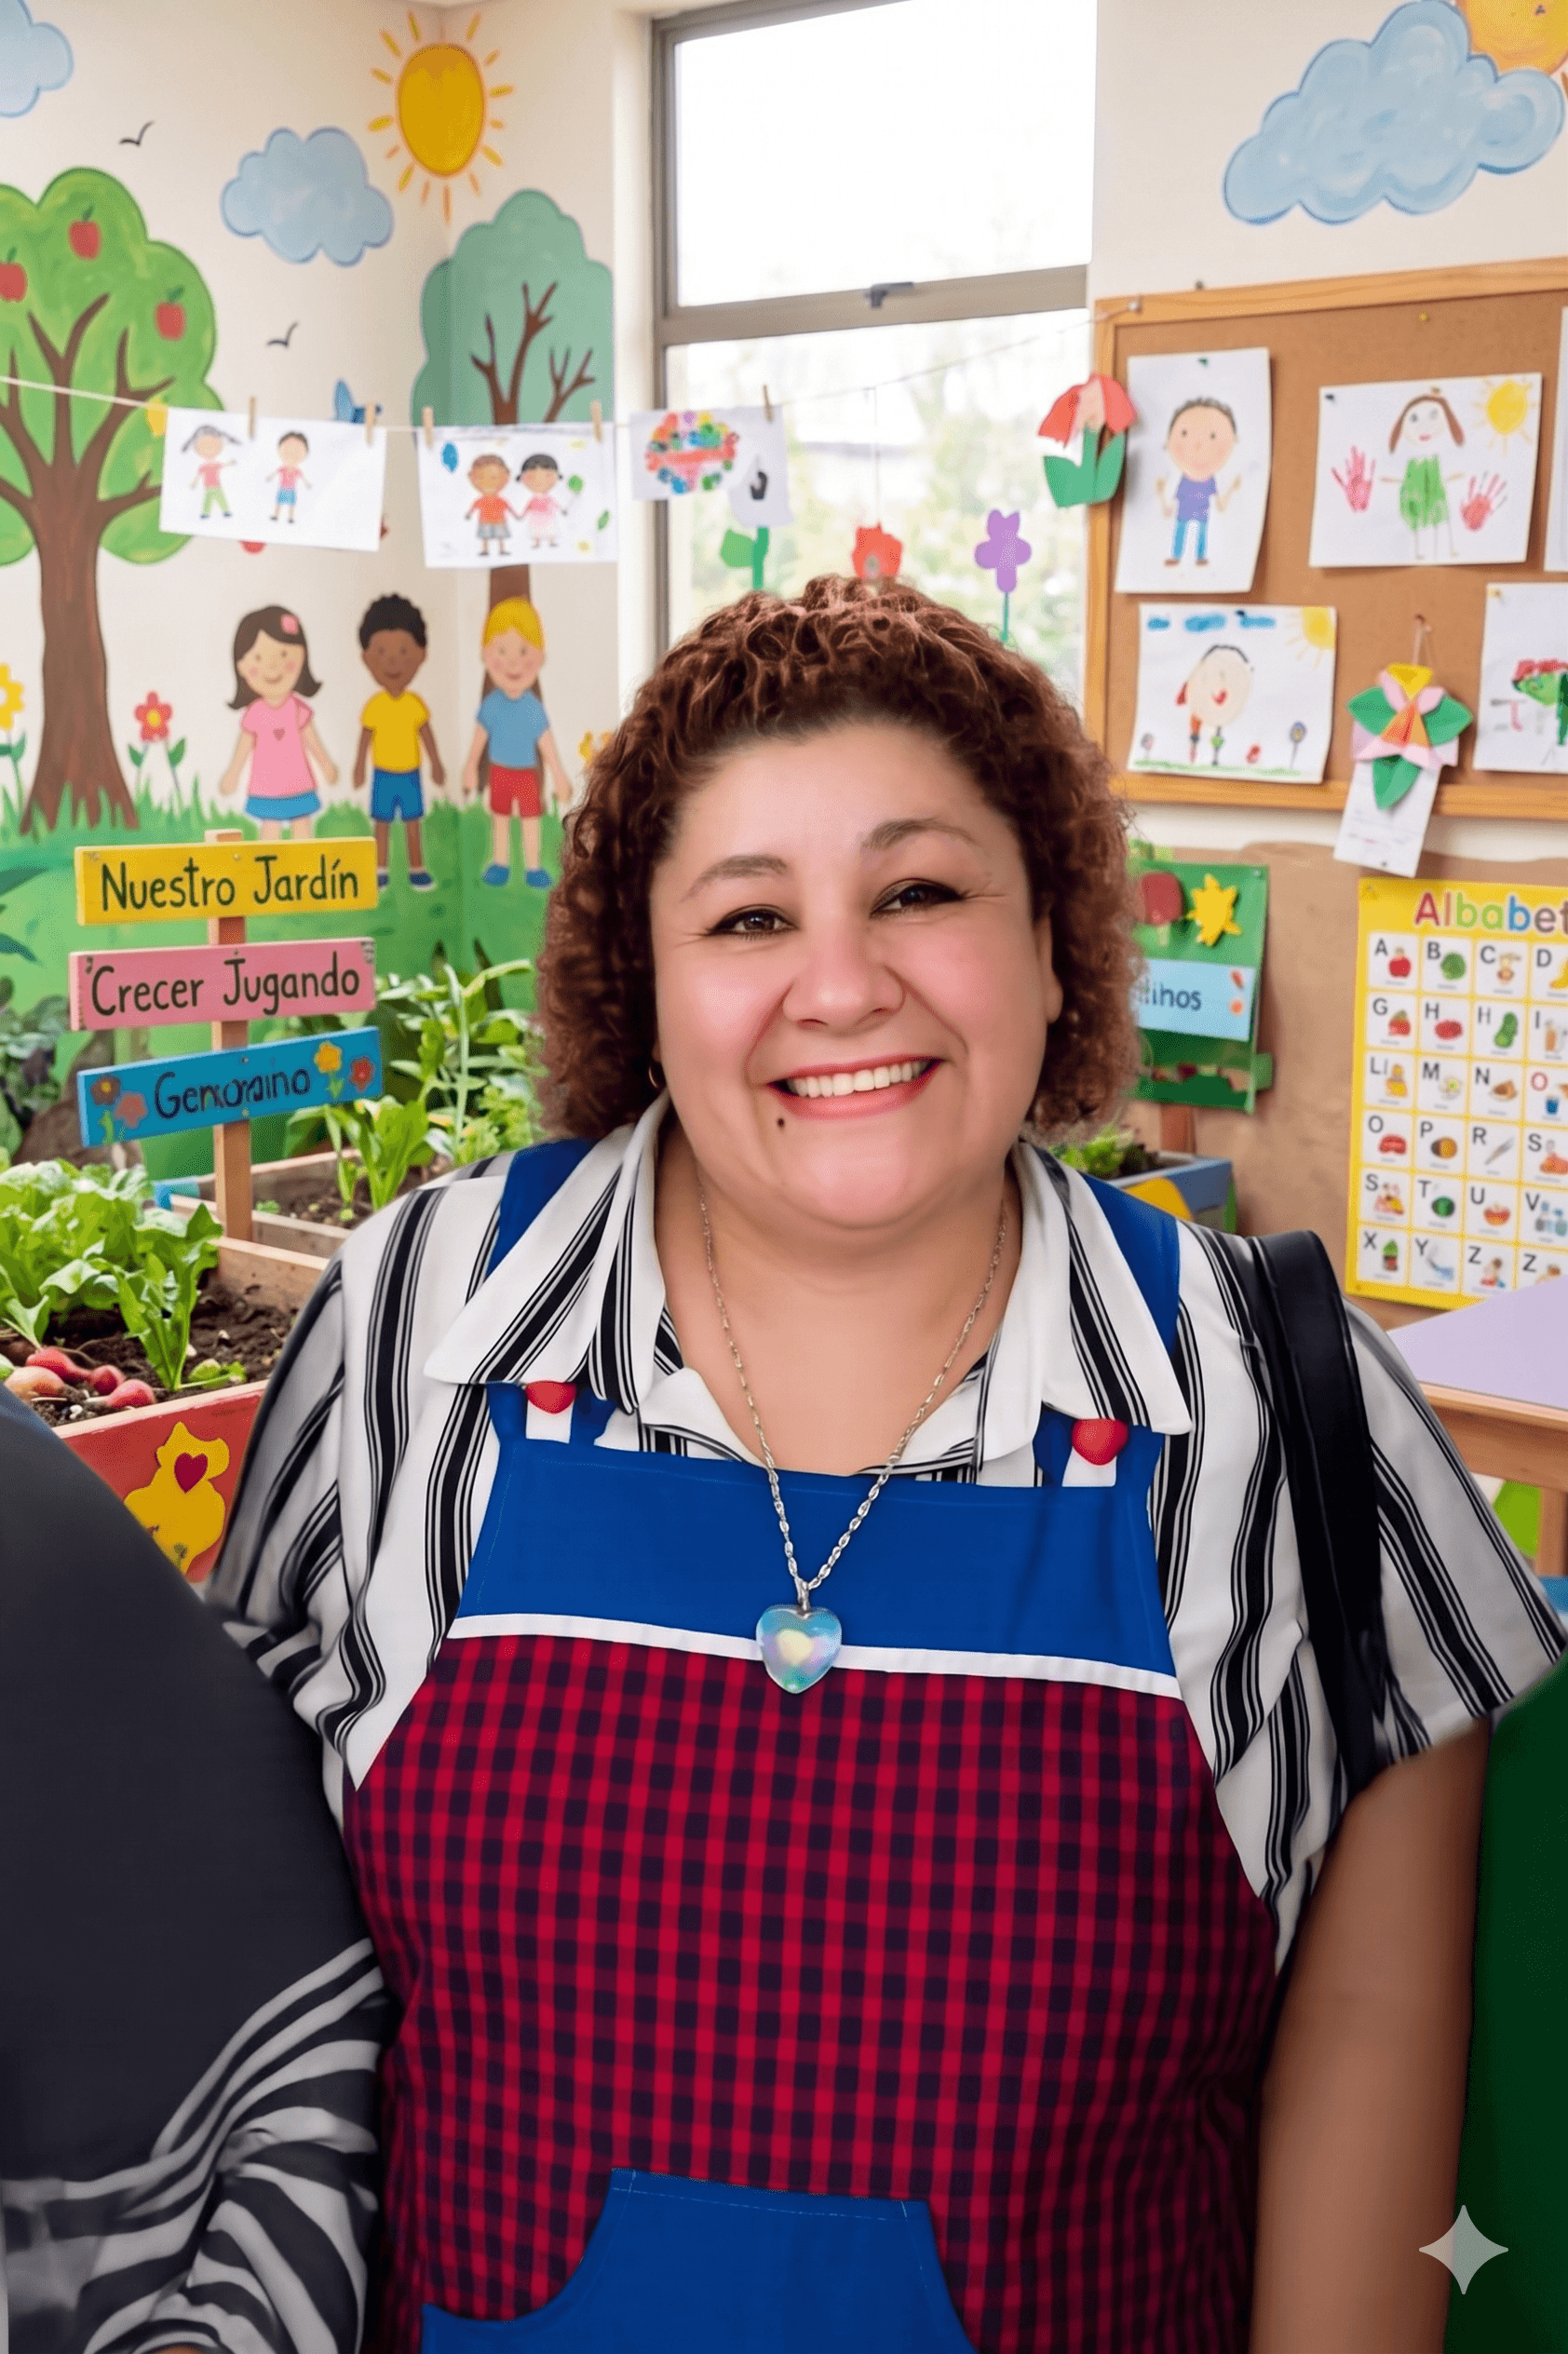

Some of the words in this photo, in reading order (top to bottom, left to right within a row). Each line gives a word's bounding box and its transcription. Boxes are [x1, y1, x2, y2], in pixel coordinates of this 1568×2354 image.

[101, 857, 237, 912] Nuestro
[253, 854, 359, 904] Jardín
[1375, 939, 1389, 956] A
[1427, 942, 1441, 960] B
[1480, 945, 1496, 965] C
[1536, 949, 1553, 968] D
[91, 965, 205, 1017] Crecer
[223, 950, 360, 1016] Jugando
[1372, 997, 1389, 1017] G
[1426, 1004, 1440, 1021] H
[1478, 1007, 1492, 1024] H
[1423, 1062, 1440, 1080] M
[1476, 1067, 1490, 1086] N
[1368, 1115, 1385, 1134] O
[1420, 1121, 1434, 1138] P
[1473, 1127, 1487, 1145] R
[1528, 1133, 1543, 1153] S
[1366, 1173, 1380, 1193] S
[1418, 1180, 1432, 1198] T
[1470, 1187, 1486, 1206] U
[1526, 1194, 1540, 1211] V
[1365, 1233, 1377, 1250] X
[1415, 1239, 1429, 1256] Y
[1468, 1246, 1481, 1265] Z
[1522, 1254, 1537, 1273] Z
